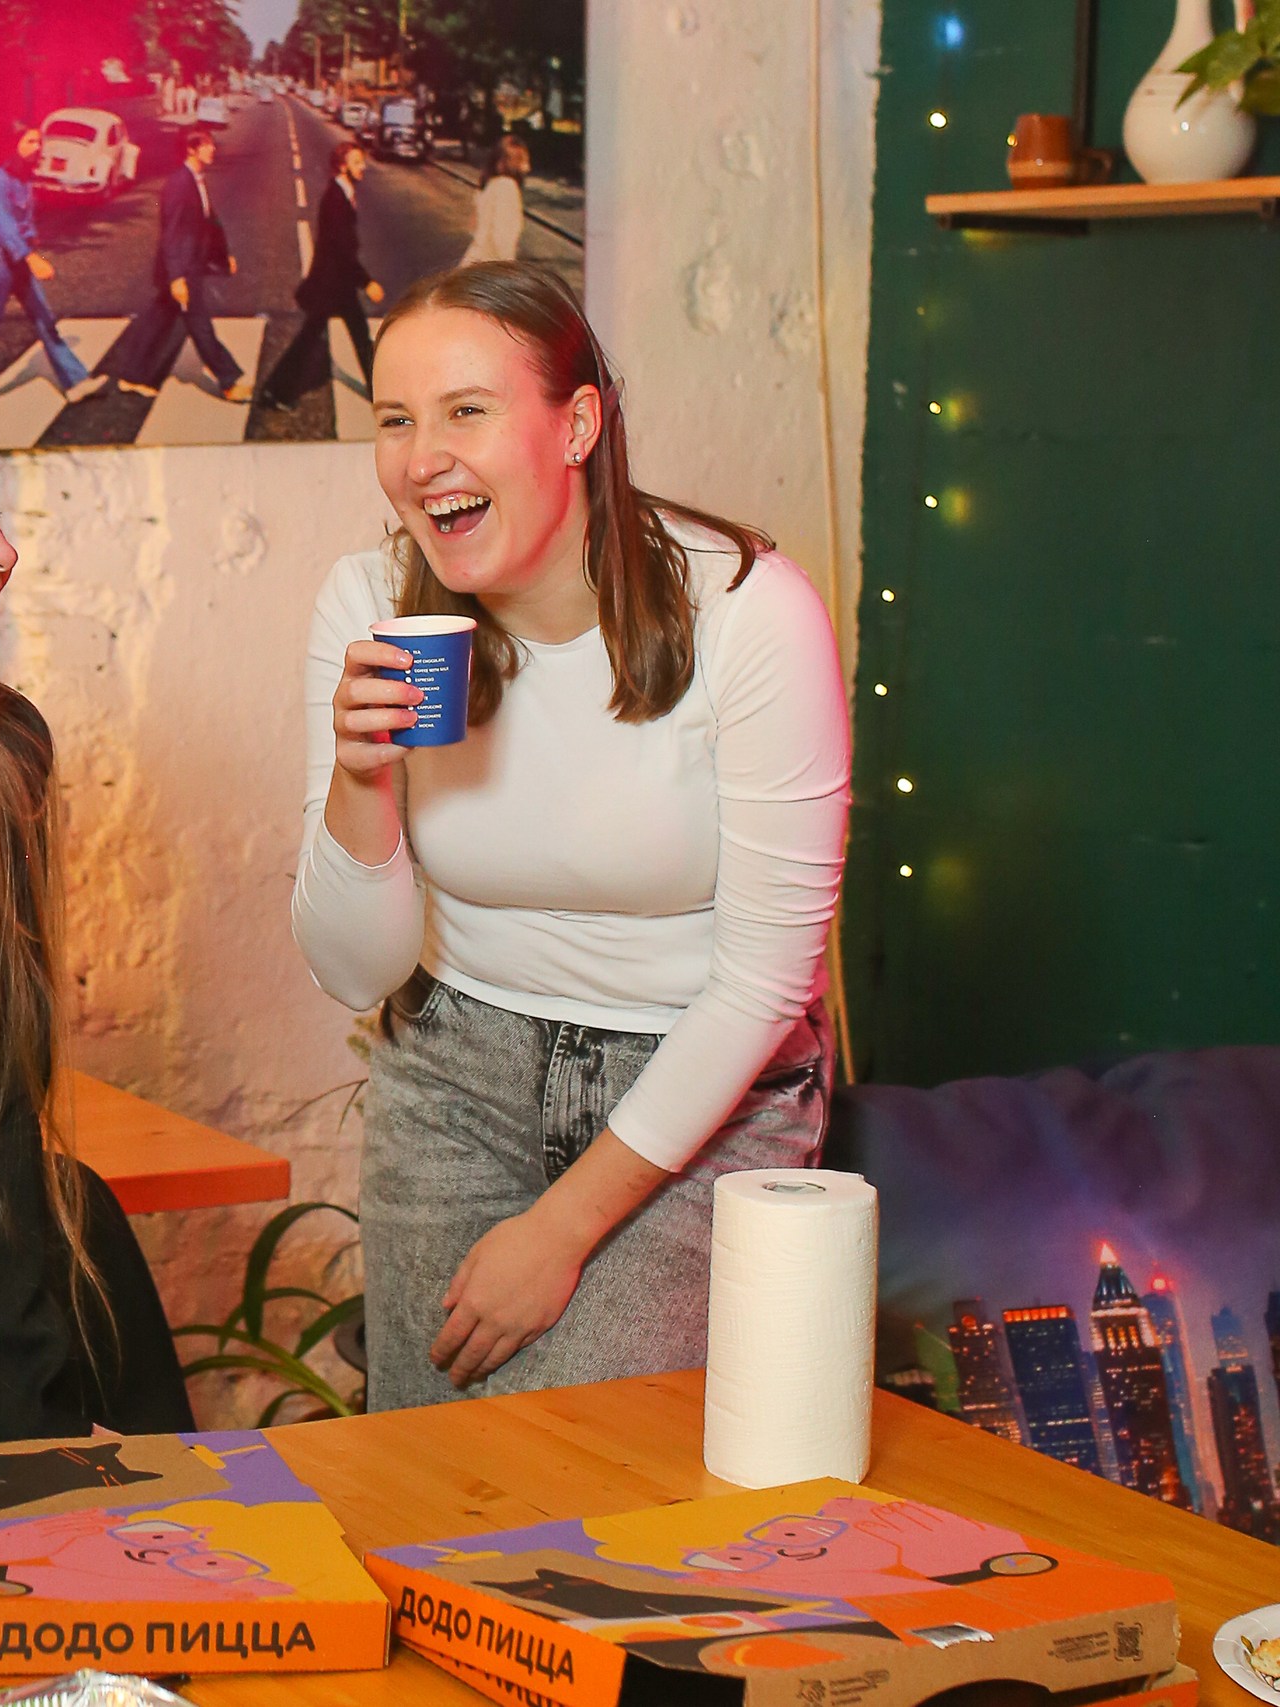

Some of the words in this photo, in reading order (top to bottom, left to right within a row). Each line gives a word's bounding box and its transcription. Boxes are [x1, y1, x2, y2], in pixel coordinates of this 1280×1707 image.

[146, 1622, 316, 1659] ПИЦЦА
[397, 1586, 471, 1642] ДОДО
[476, 1615, 574, 1684] ПИЦЦА
